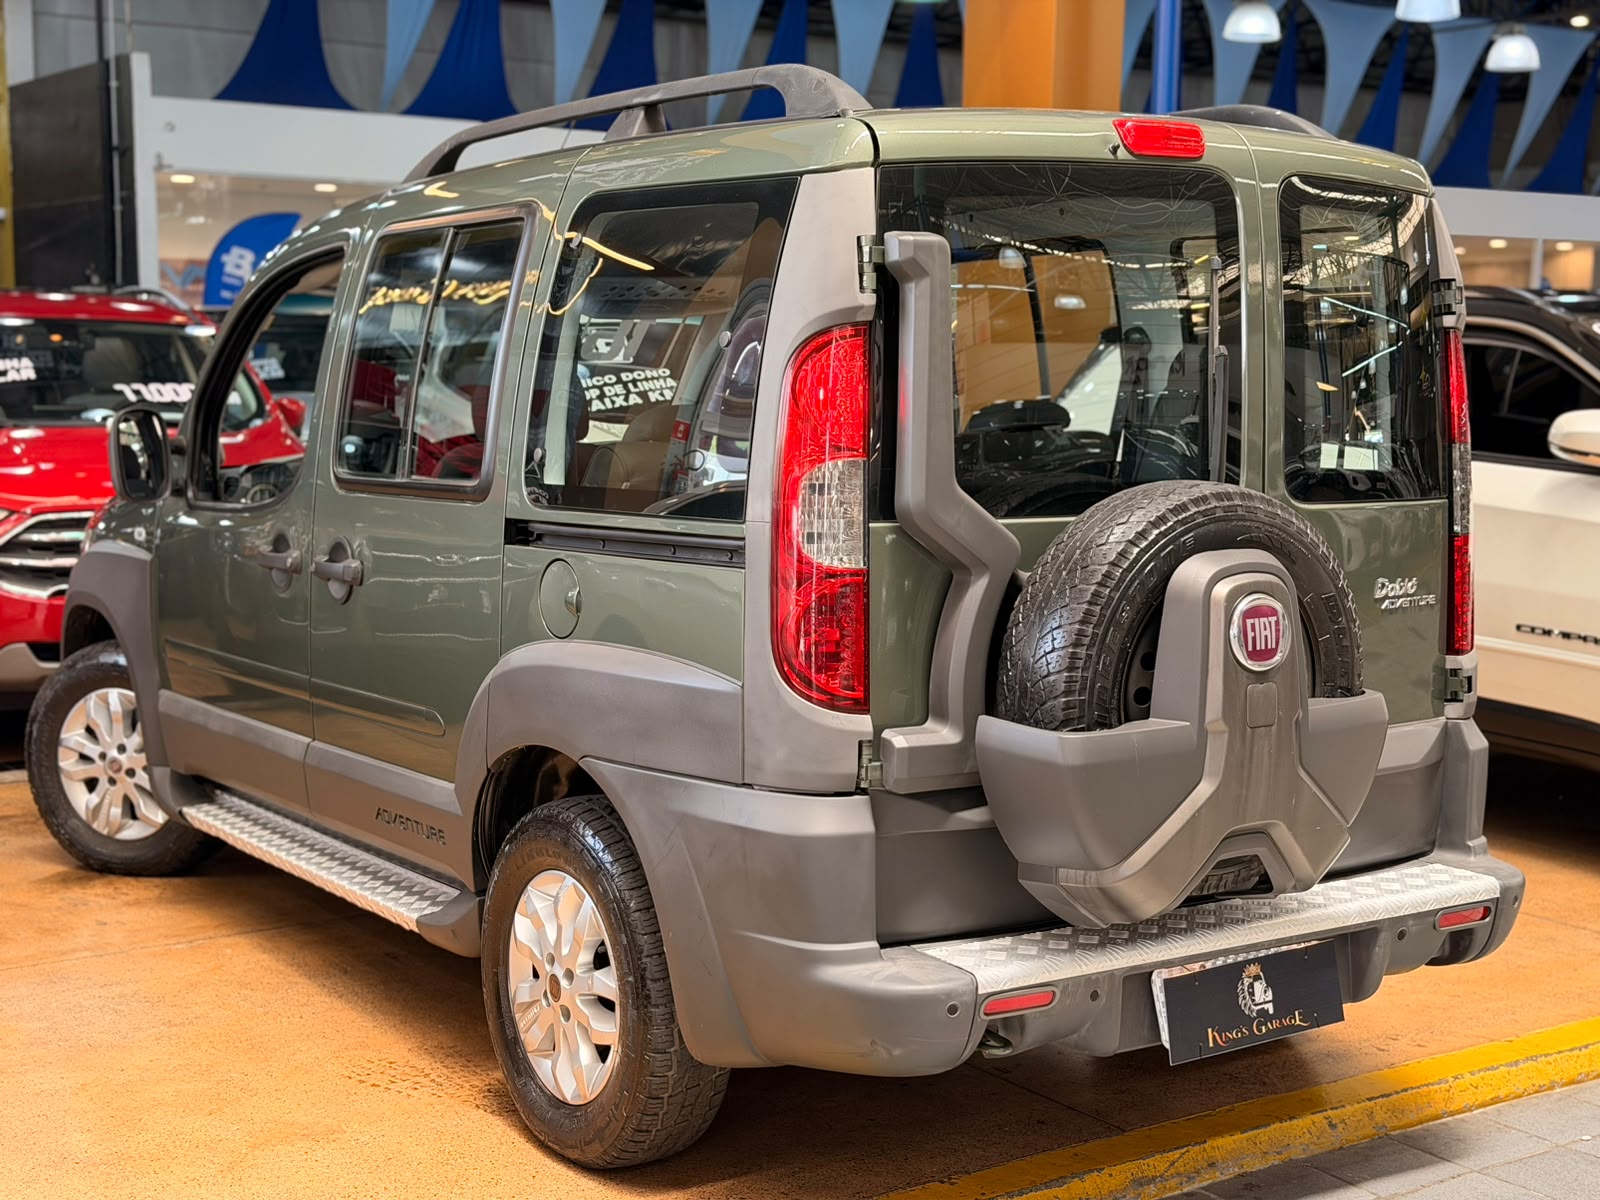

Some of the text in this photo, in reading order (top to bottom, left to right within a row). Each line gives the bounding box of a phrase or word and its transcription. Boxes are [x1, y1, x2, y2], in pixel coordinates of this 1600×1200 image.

[620, 368, 671, 382] DONO
[602, 384, 627, 397] DE
[627, 377, 678, 393] LINHA
[1246, 616, 1277, 652] FIAT
[1515, 624, 1600, 645] COMPA
[375, 807, 446, 846] ADVENTURE
